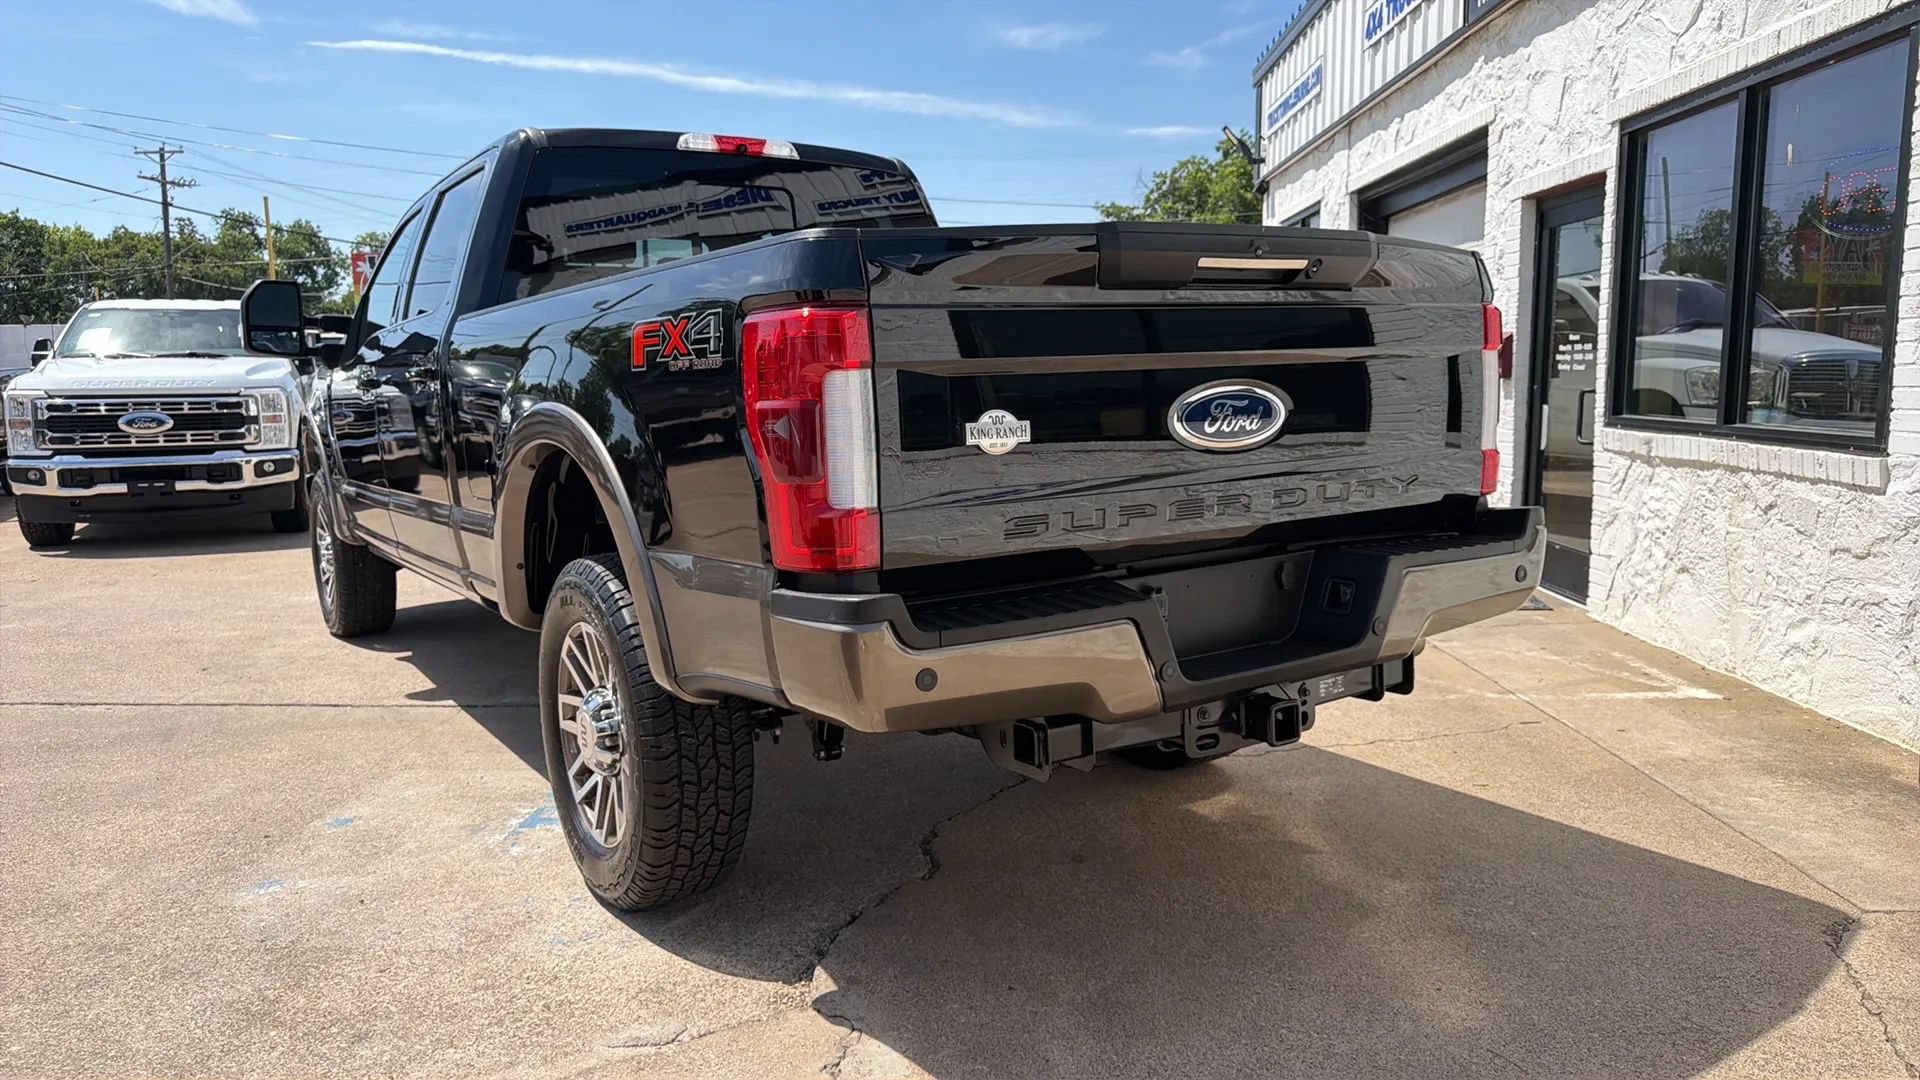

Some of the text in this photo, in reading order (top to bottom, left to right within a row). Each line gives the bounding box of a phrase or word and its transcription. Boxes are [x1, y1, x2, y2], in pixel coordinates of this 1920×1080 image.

[1365, 2, 1383, 42] 4X4
[631, 308, 723, 372] FX4
[669, 357, 723, 371] OFF ROAD
[72, 379, 217, 388] SUPER DUTY
[132, 416, 158, 428] Ford
[1203, 398, 1263, 434] Ford
[969, 424, 1028, 440] KING RANCH
[1002, 473, 1420, 541] SUPER DUTY
